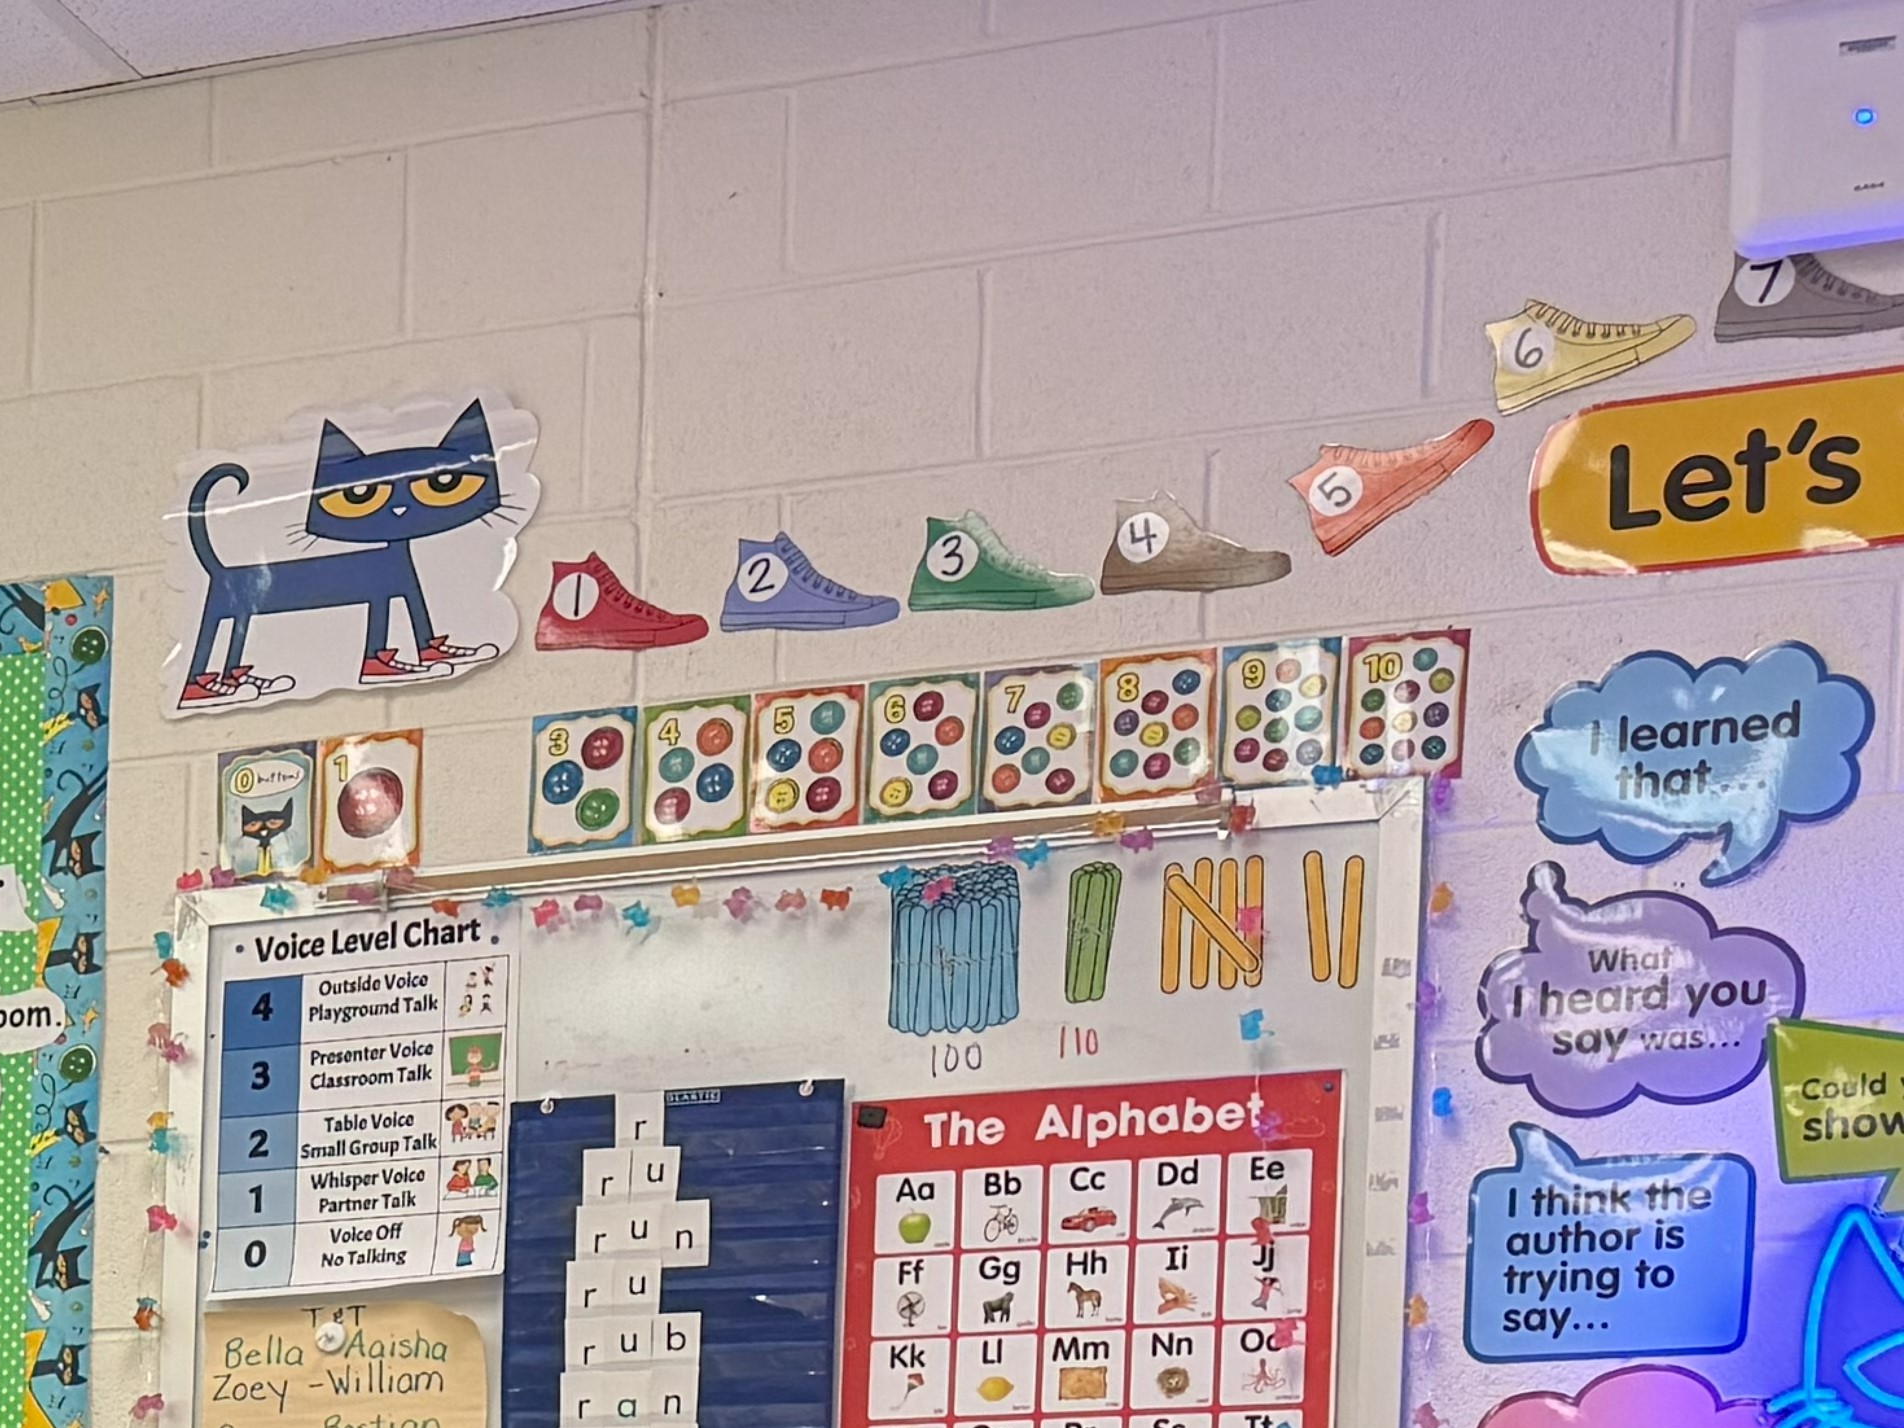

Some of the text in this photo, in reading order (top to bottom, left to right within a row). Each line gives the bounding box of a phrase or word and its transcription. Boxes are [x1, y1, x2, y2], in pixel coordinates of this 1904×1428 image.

[1750, 260, 1783, 304] 7
[1513, 327, 1543, 368] 6
[1609, 419, 1863, 531] Let's
[1591, 700, 1800, 753] I learned
[255, 918, 481, 962] Voice Level Chart
[1588, 946, 1673, 973] What
[319, 972, 428, 996] Outside Voice
[1512, 973, 1766, 1018] I heard you
[251, 994, 273, 1020] 4
[308, 994, 437, 1025] Playground Talk
[932, 1043, 981, 1078] 100
[1552, 1028, 1740, 1059] say was...
[251, 1061, 270, 1090] 3
[924, 1093, 1263, 1147] The Alphabet
[249, 1129, 269, 1158] 2
[896, 1157, 1284, 1202] Aa Bb Cc Dd Ee
[249, 1185, 262, 1213] 1
[1507, 1179, 1711, 1218] I think the
[330, 1222, 403, 1243] Voice Off
[1507, 1219, 1684, 1256] author is
[245, 1240, 266, 1267] 0
[322, 1248, 407, 1268] No Talking
[1503, 1260, 1674, 1301] trying to
[1503, 1307, 1608, 1339] say...
[225, 1335, 303, 1369] Bella
